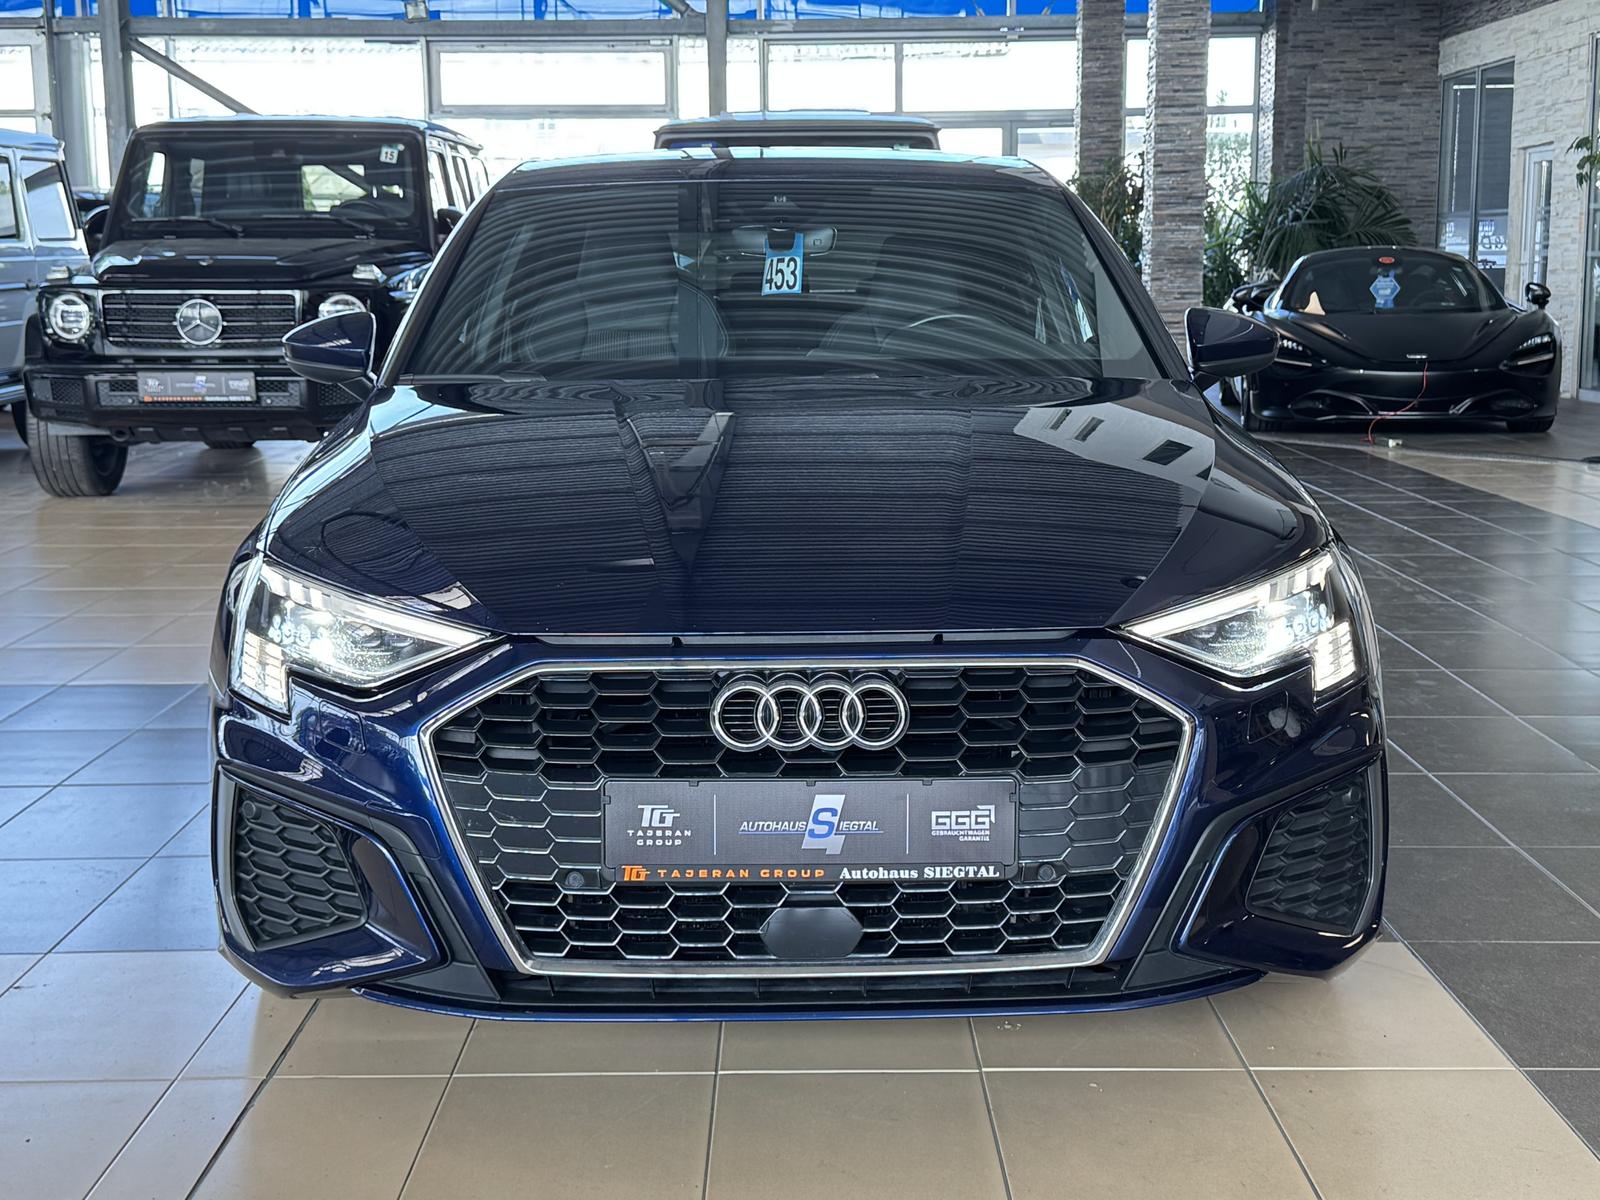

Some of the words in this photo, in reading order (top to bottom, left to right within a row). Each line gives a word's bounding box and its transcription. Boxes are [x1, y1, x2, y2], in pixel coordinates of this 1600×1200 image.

[765, 257, 798, 290] 453
[739, 821, 807, 831] AUTOHAUS
[931, 810, 990, 830] GGG
[657, 869, 749, 878] TAJERAN
[760, 869, 825, 878] GROUP
[839, 867, 919, 879] Autohaus
[923, 866, 999, 878] SIEGTAL
